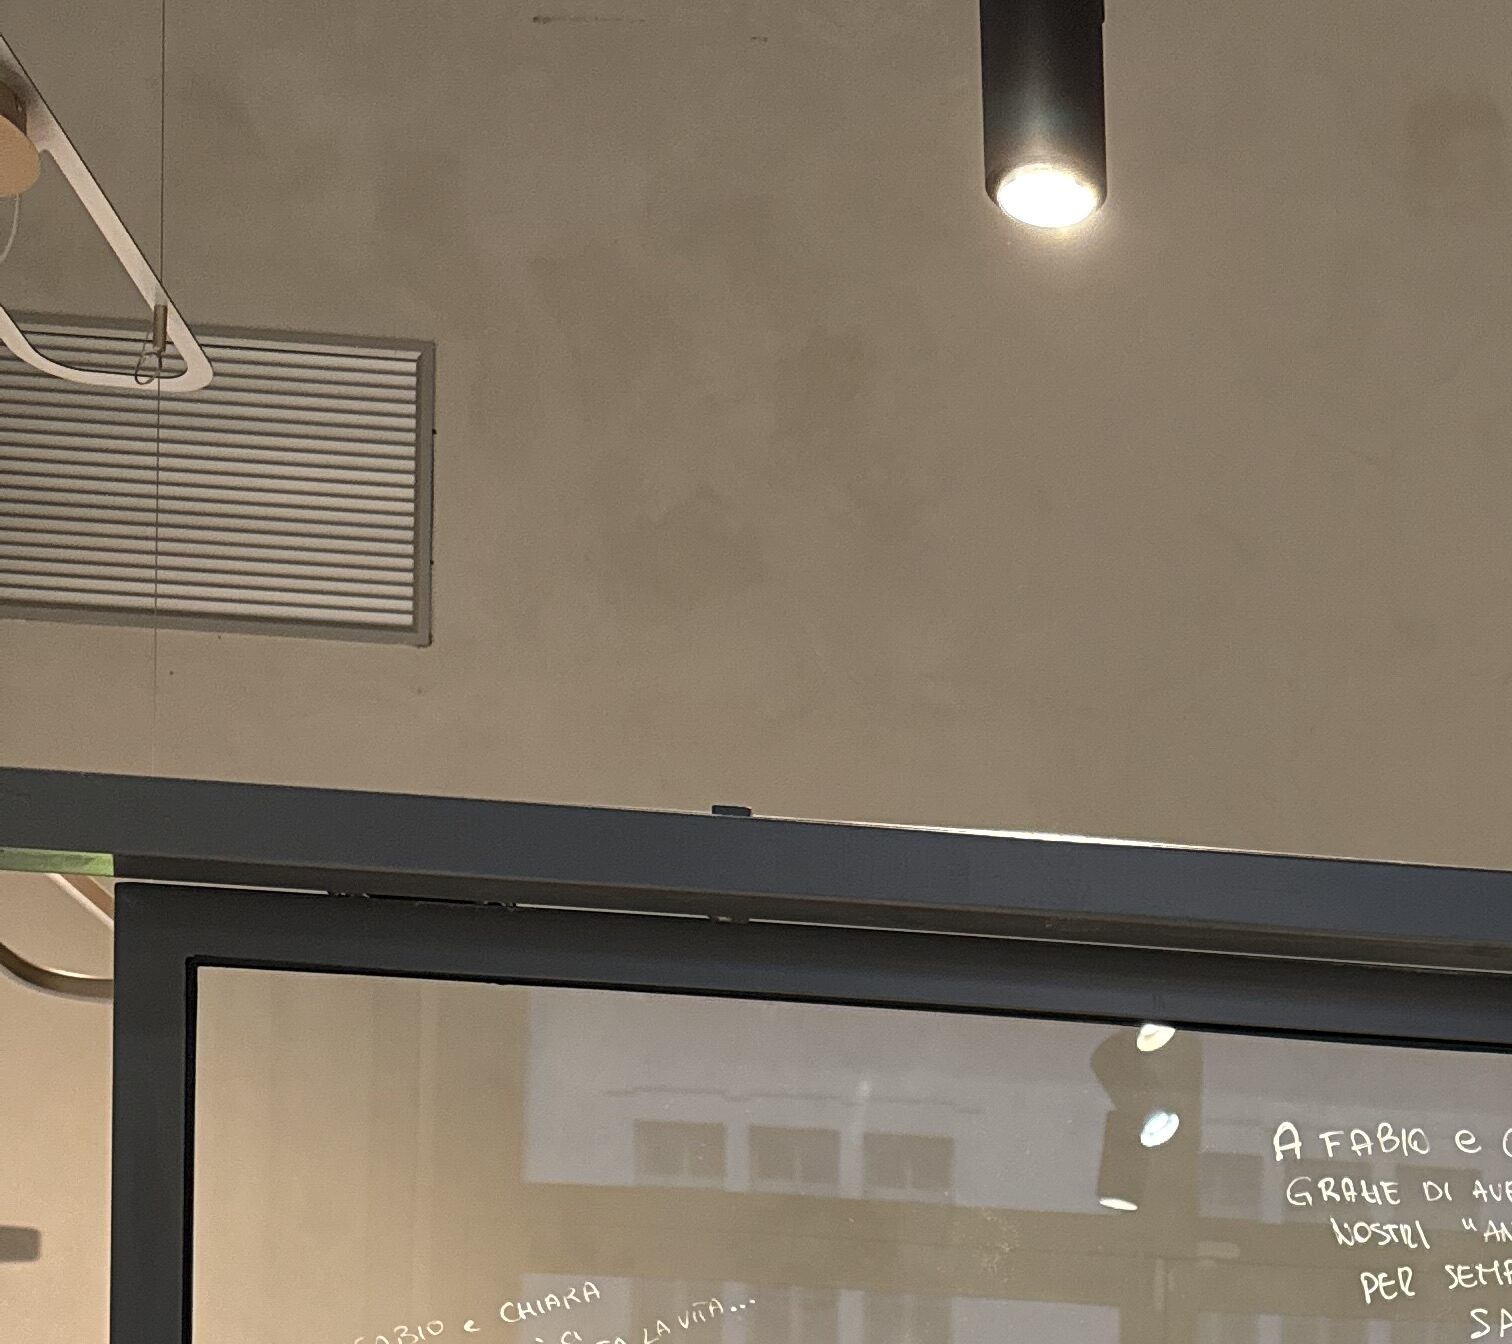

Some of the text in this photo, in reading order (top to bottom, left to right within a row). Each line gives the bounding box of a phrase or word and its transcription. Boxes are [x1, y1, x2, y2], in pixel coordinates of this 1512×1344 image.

[1273, 1121, 1302, 1161] A
[1320, 1122, 1430, 1158] FABIO
[1423, 1181, 1453, 1201] DI
[1331, 1217, 1431, 1250] NOSTRI
[500, 1281, 600, 1324] CHIARA
[1361, 1267, 1416, 1304] PER
